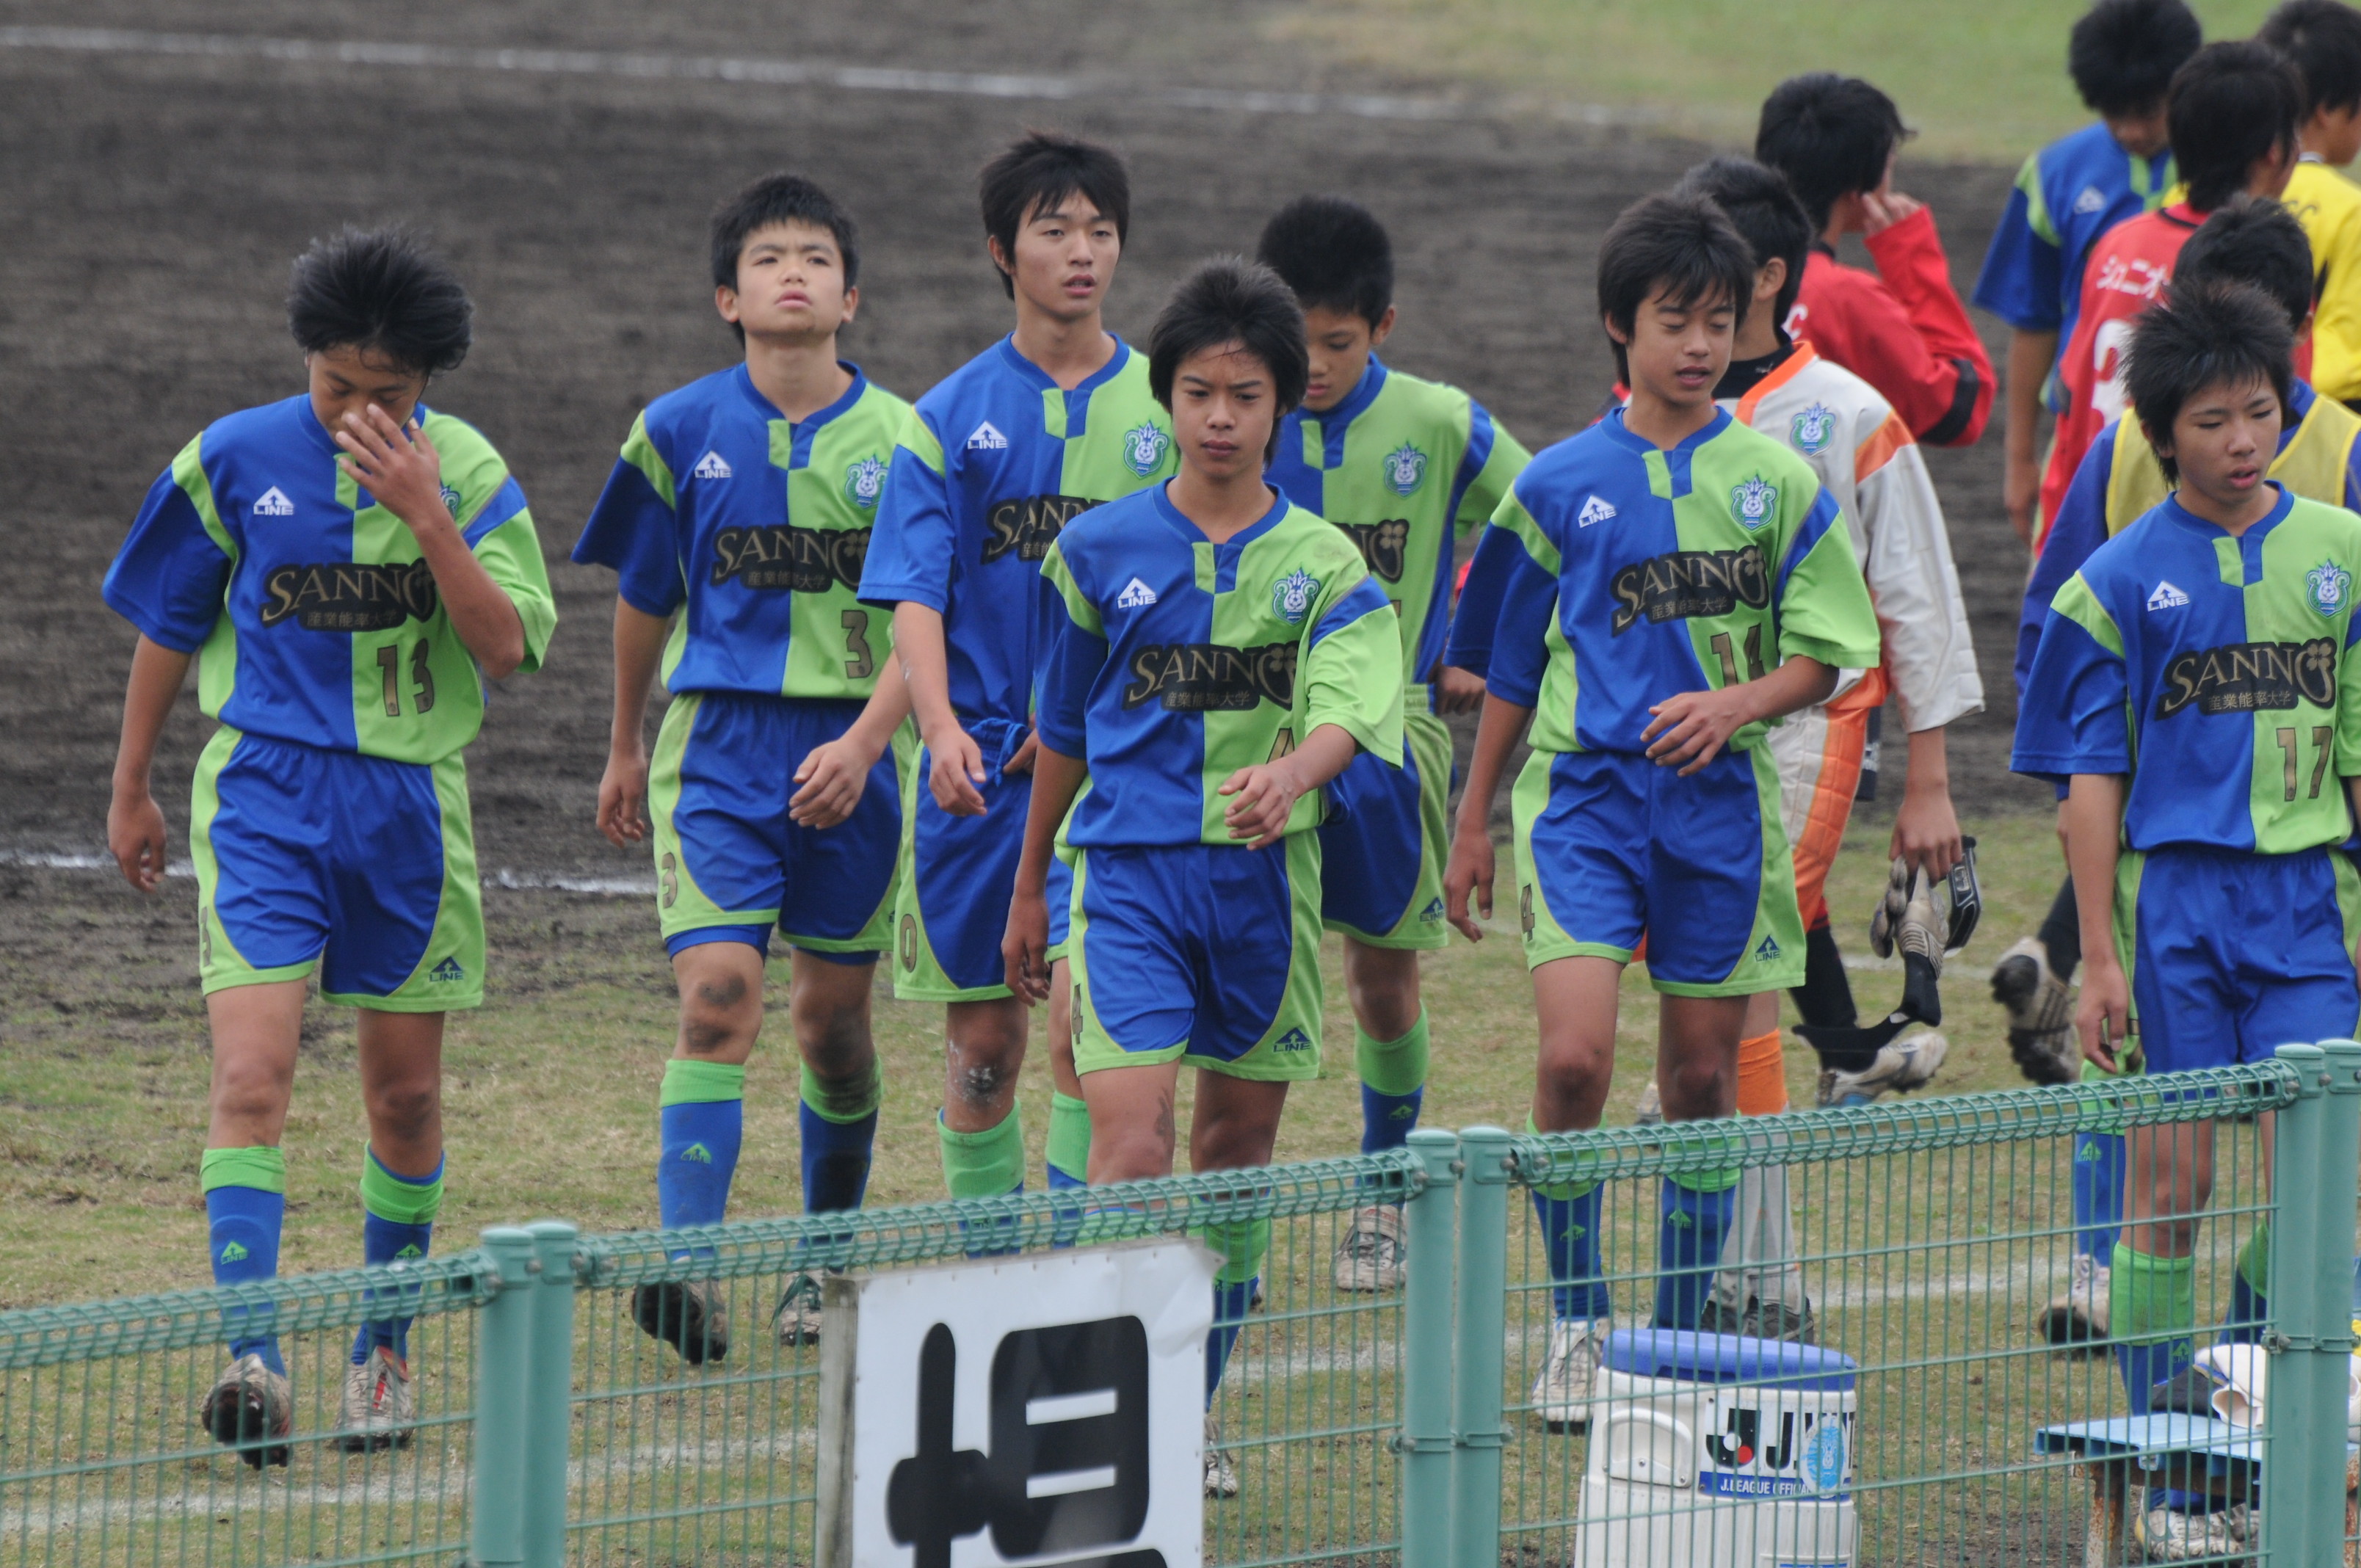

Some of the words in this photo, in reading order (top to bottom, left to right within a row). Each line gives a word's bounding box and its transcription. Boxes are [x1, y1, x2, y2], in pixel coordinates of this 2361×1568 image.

[968, 440, 1007, 450] LINE
[694, 469, 731, 479] LINE
[253, 505, 294, 516] LINE
[1578, 509, 1617, 528] LINE
[715, 530, 870, 587] SANNO
[262, 561, 434, 622] SANNO
[1617, 549, 1766, 628] SANNO
[1118, 594, 1157, 609] LINE
[2147, 596, 2190, 611] LINE
[841, 609, 873, 678] 3
[376, 637, 435, 717] 13
[1129, 646, 1297, 704] SANNO
[2164, 642, 2332, 713] SANNO
[2208, 690, 2292, 712] 産業能率大学
[2276, 725, 2333, 802] 17
[661, 852, 678, 910] 3
[899, 913, 918, 973] 0
[1755, 951, 1781, 962] LINE
[429, 971, 464, 982] LINE
[1273, 1042, 1310, 1053] LINE
[1720, 1478, 1771, 1495] J.LEAGUE
